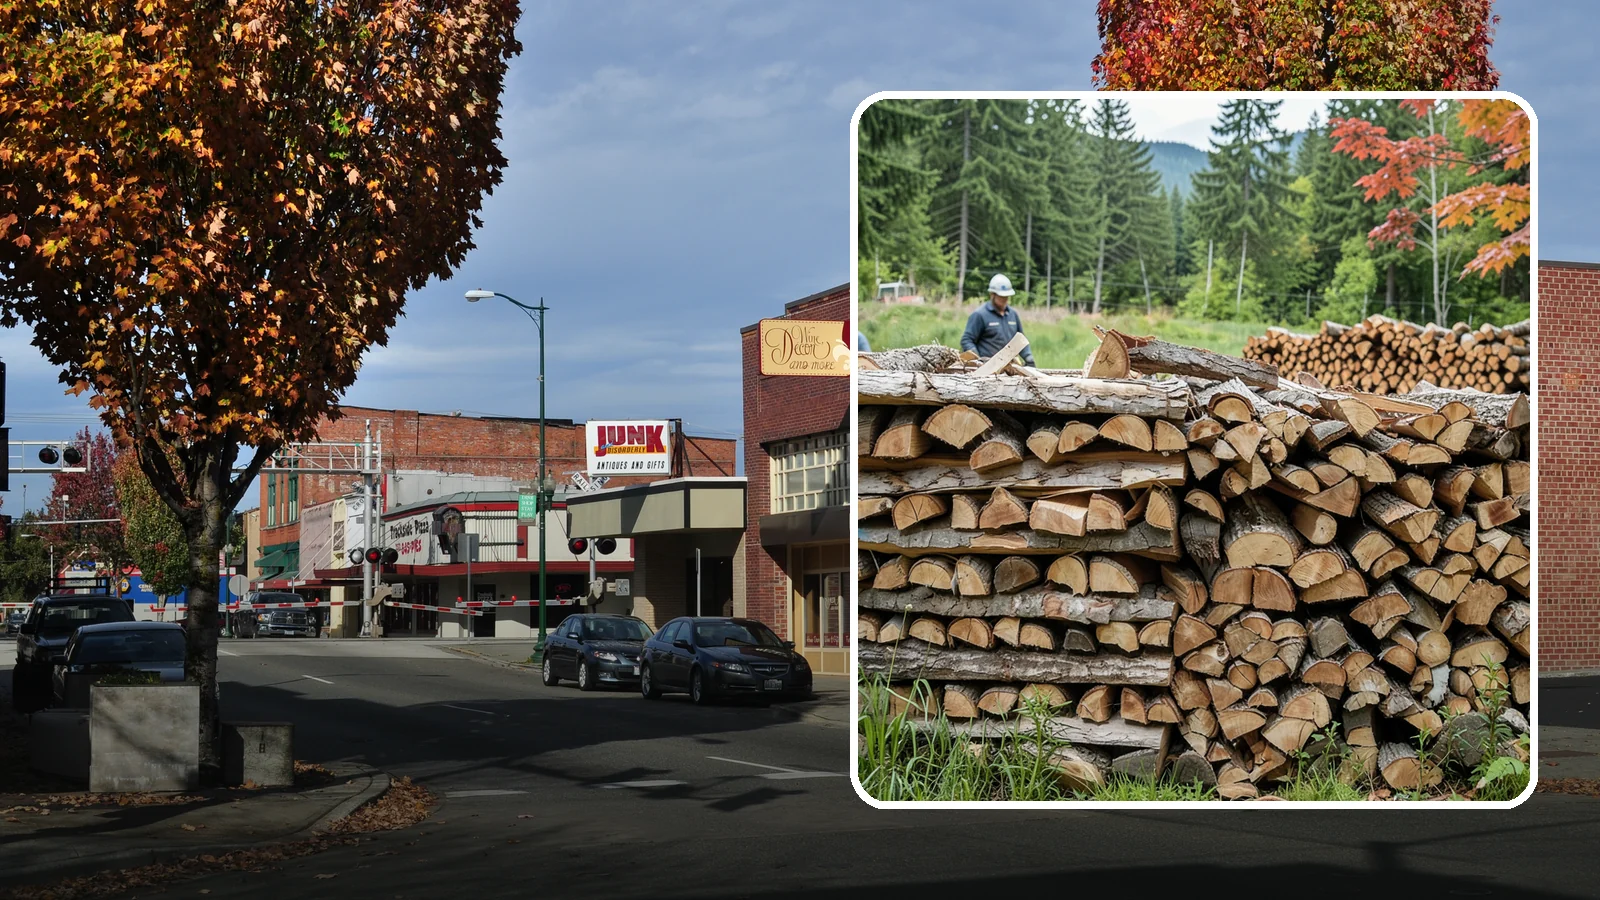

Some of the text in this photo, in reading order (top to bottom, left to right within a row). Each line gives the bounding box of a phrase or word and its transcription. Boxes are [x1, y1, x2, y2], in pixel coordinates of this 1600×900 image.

[595, 425, 664, 457] JUNK
[607, 446, 646, 454] DISORDERLY
[596, 460, 665, 470] ANTIQUES AND GIFTS
[390, 519, 429, 540] Trackside Pizza
